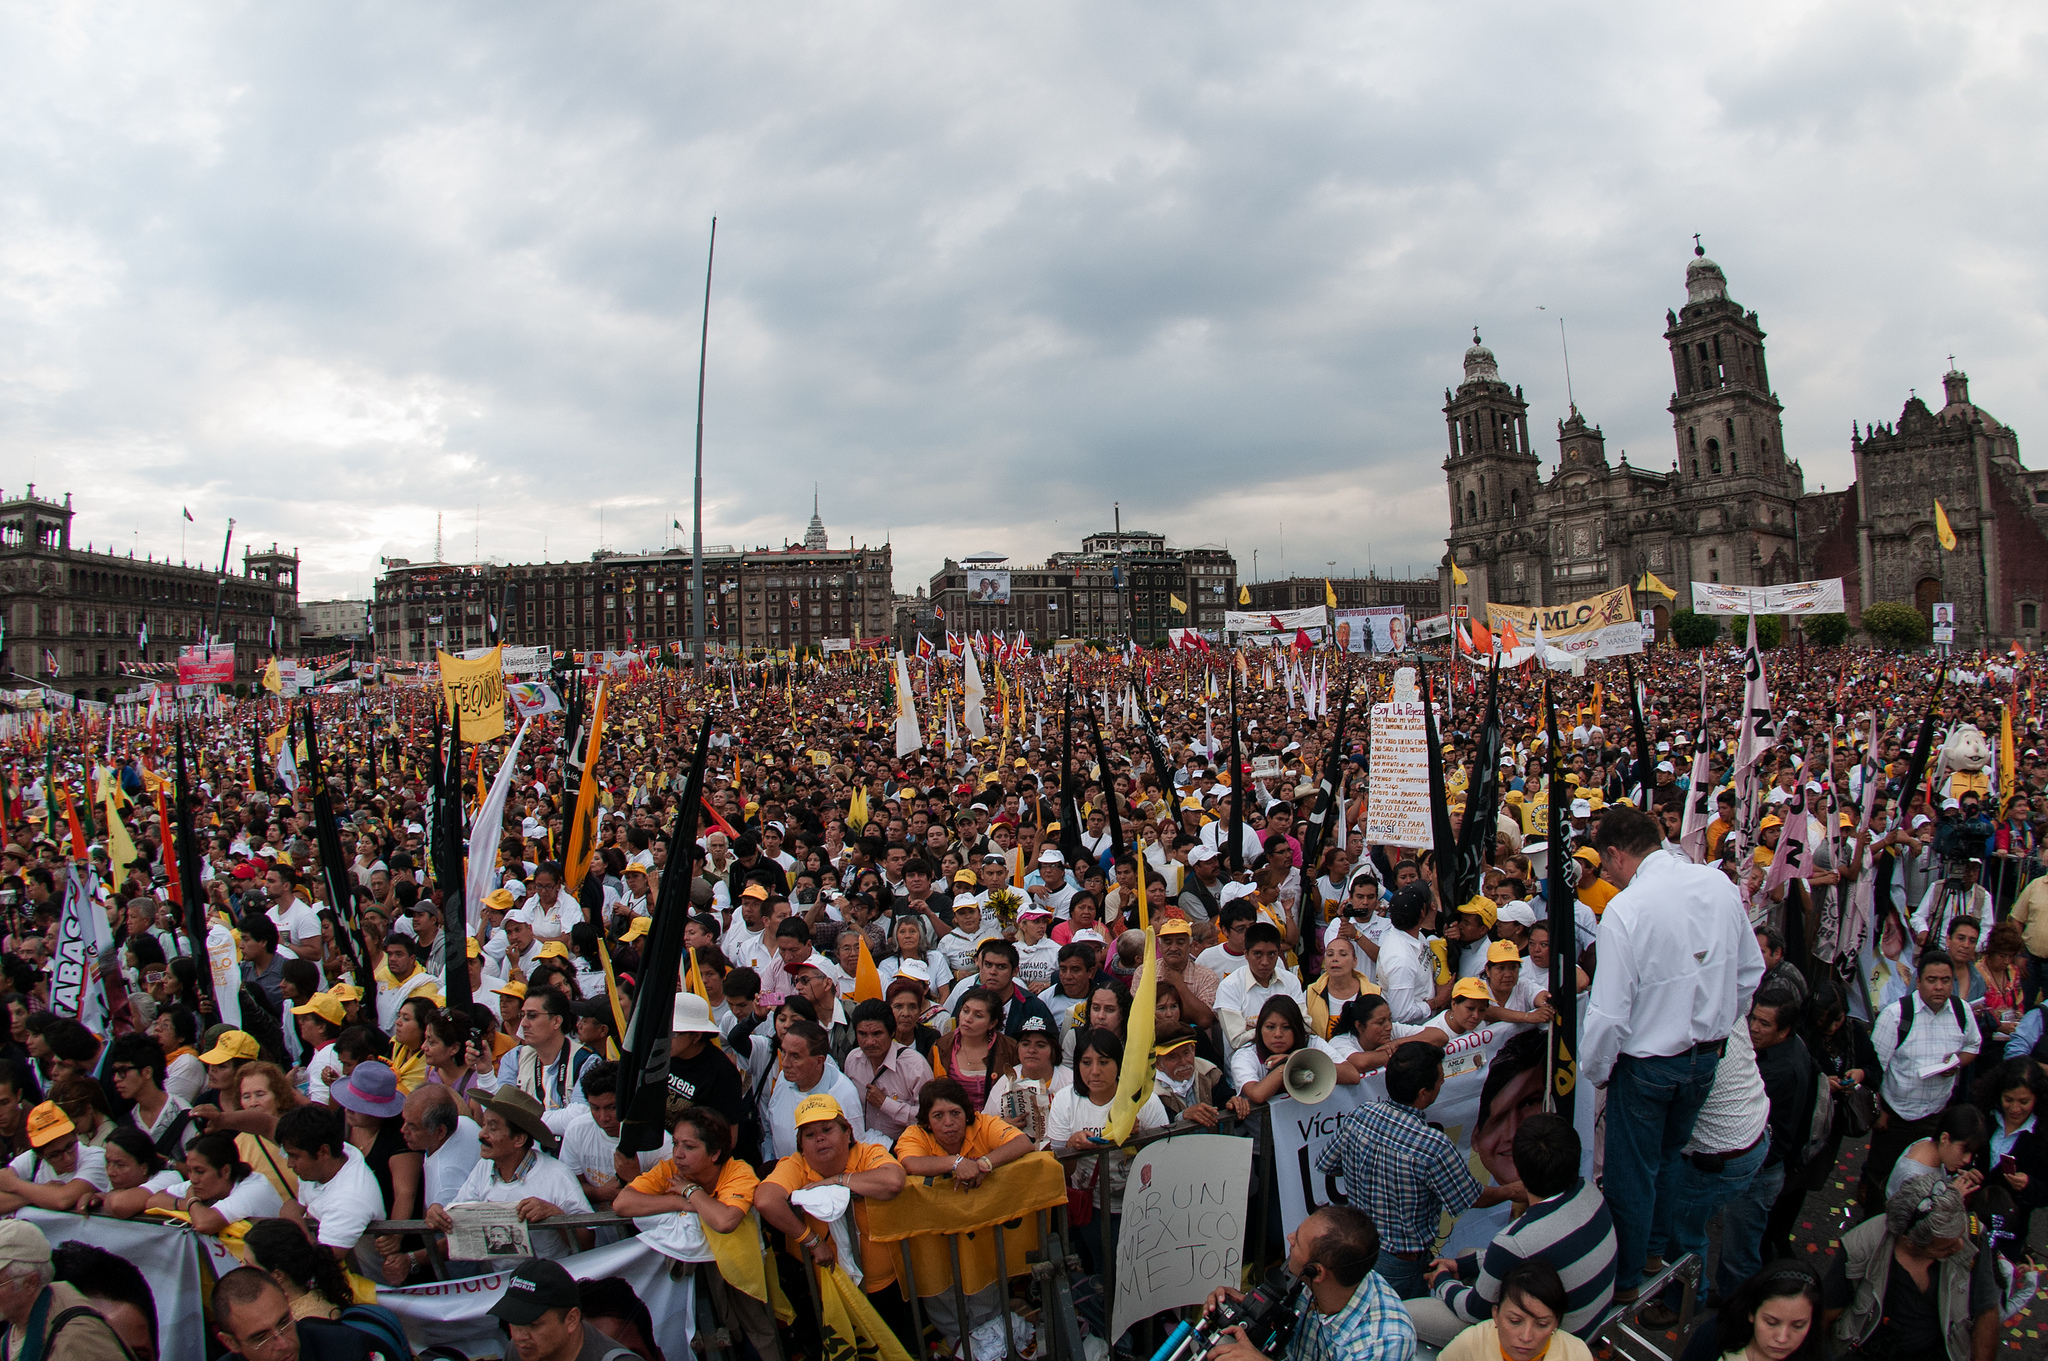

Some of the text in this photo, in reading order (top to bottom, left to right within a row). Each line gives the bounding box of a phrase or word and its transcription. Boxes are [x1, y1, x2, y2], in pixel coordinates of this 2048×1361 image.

[1348, 608, 1367, 617] POPULAR
[1367, 607, 1391, 616] FRANCISCO
[1391, 606, 1404, 615] VILLA
[1457, 608, 1467, 617] PT
[1488, 606, 1525, 619] PRESIDENTE
[1528, 604, 1594, 631] AMLO
[1565, 637, 1599, 652] LOBOS
[505, 657, 534, 666] Valencia
[574, 654, 584, 662] PT
[1373, 703, 1389, 718] Soy
[1393, 703, 1402, 716] Un
[1446, 1029, 1493, 1056] ando
[1447, 1058, 1465, 1068] AMLO
[559, 1063, 567, 1082] Canon
[667, 1072, 696, 1097] orena
[1122, 1180, 1227, 1239] POR UN
[1121, 1211, 1239, 1272] MEXICO
[1120, 1244, 1240, 1307] MEJOR
